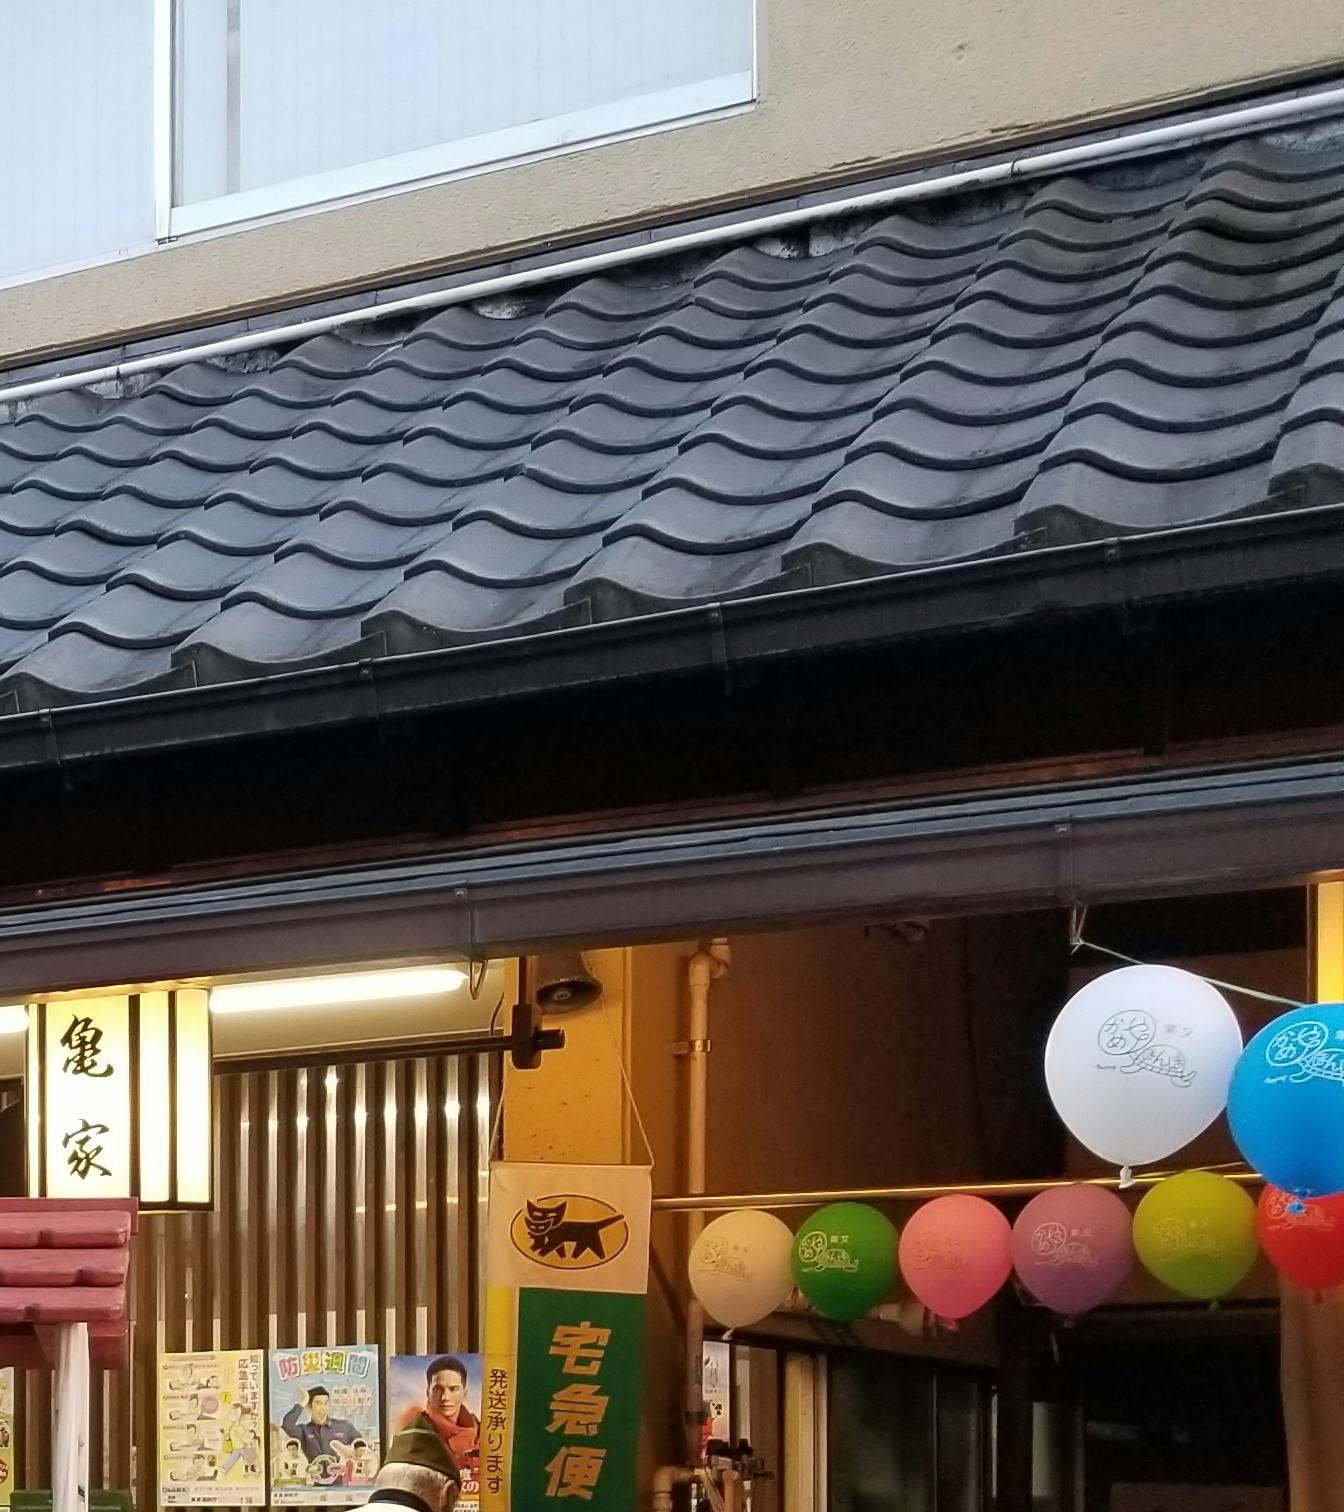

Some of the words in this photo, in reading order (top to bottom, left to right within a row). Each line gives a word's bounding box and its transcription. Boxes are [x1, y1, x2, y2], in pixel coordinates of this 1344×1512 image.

[59, 1013, 114, 1181] 亀家
[276, 1351, 370, 1379] 防災週間
[486, 1369, 509, 1494] 発送承ります
[545, 1321, 611, 1499] 宅急便
